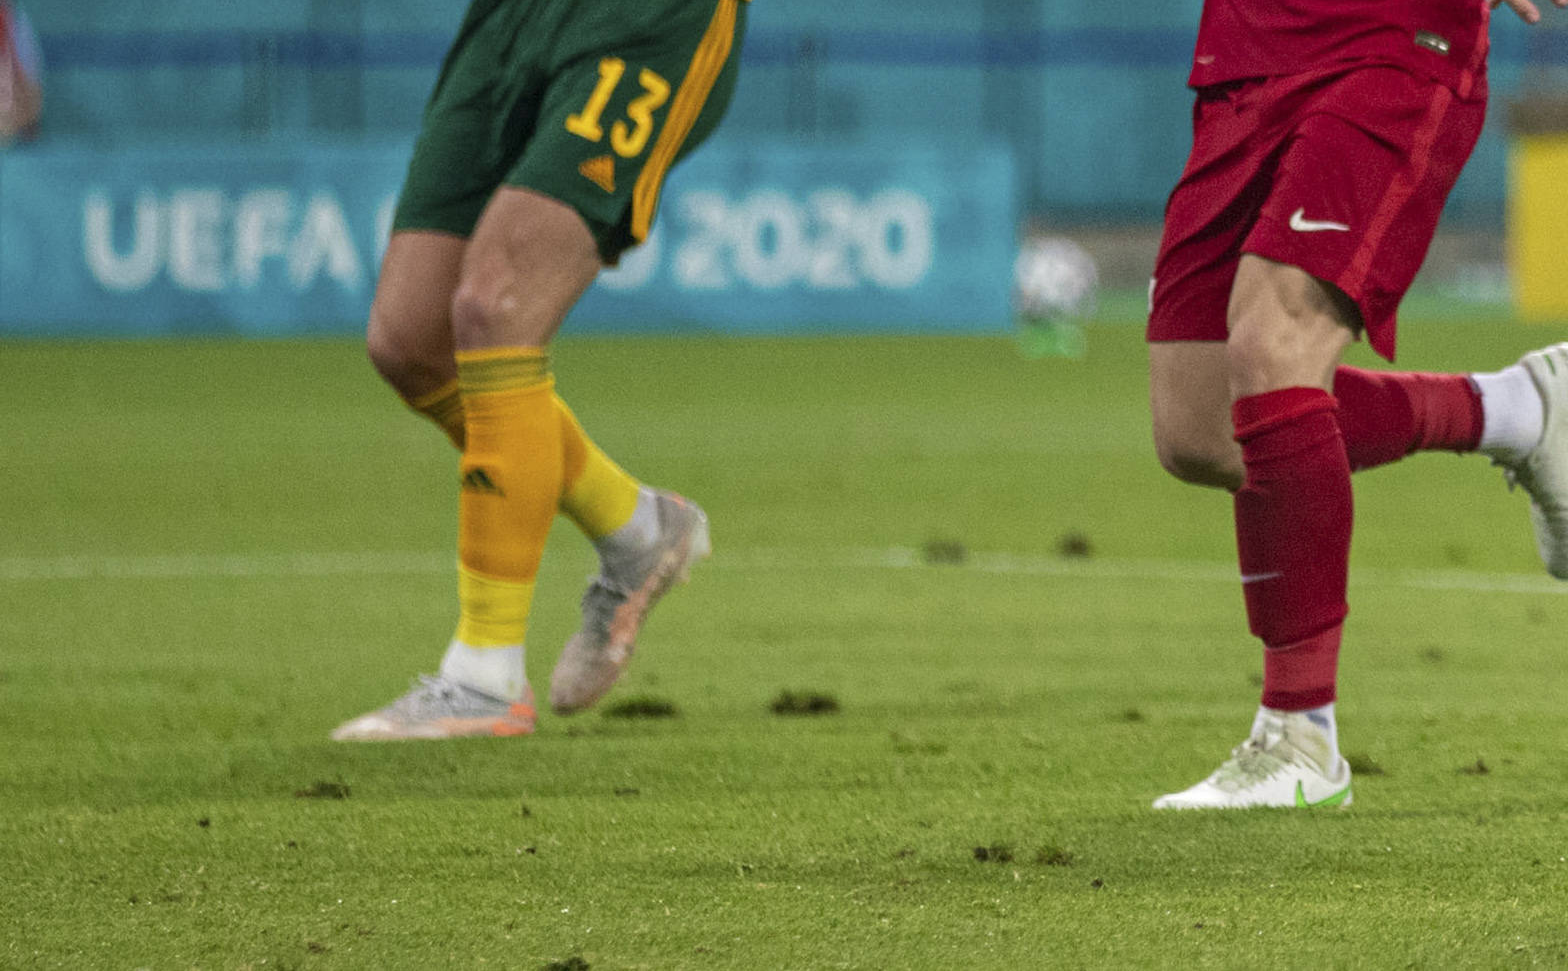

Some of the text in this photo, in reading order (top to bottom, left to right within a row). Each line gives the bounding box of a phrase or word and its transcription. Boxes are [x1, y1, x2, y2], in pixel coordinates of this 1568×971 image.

[565, 57, 672, 158] 13
[83, 186, 367, 293] UEFA
[673, 185, 933, 292] 2020
